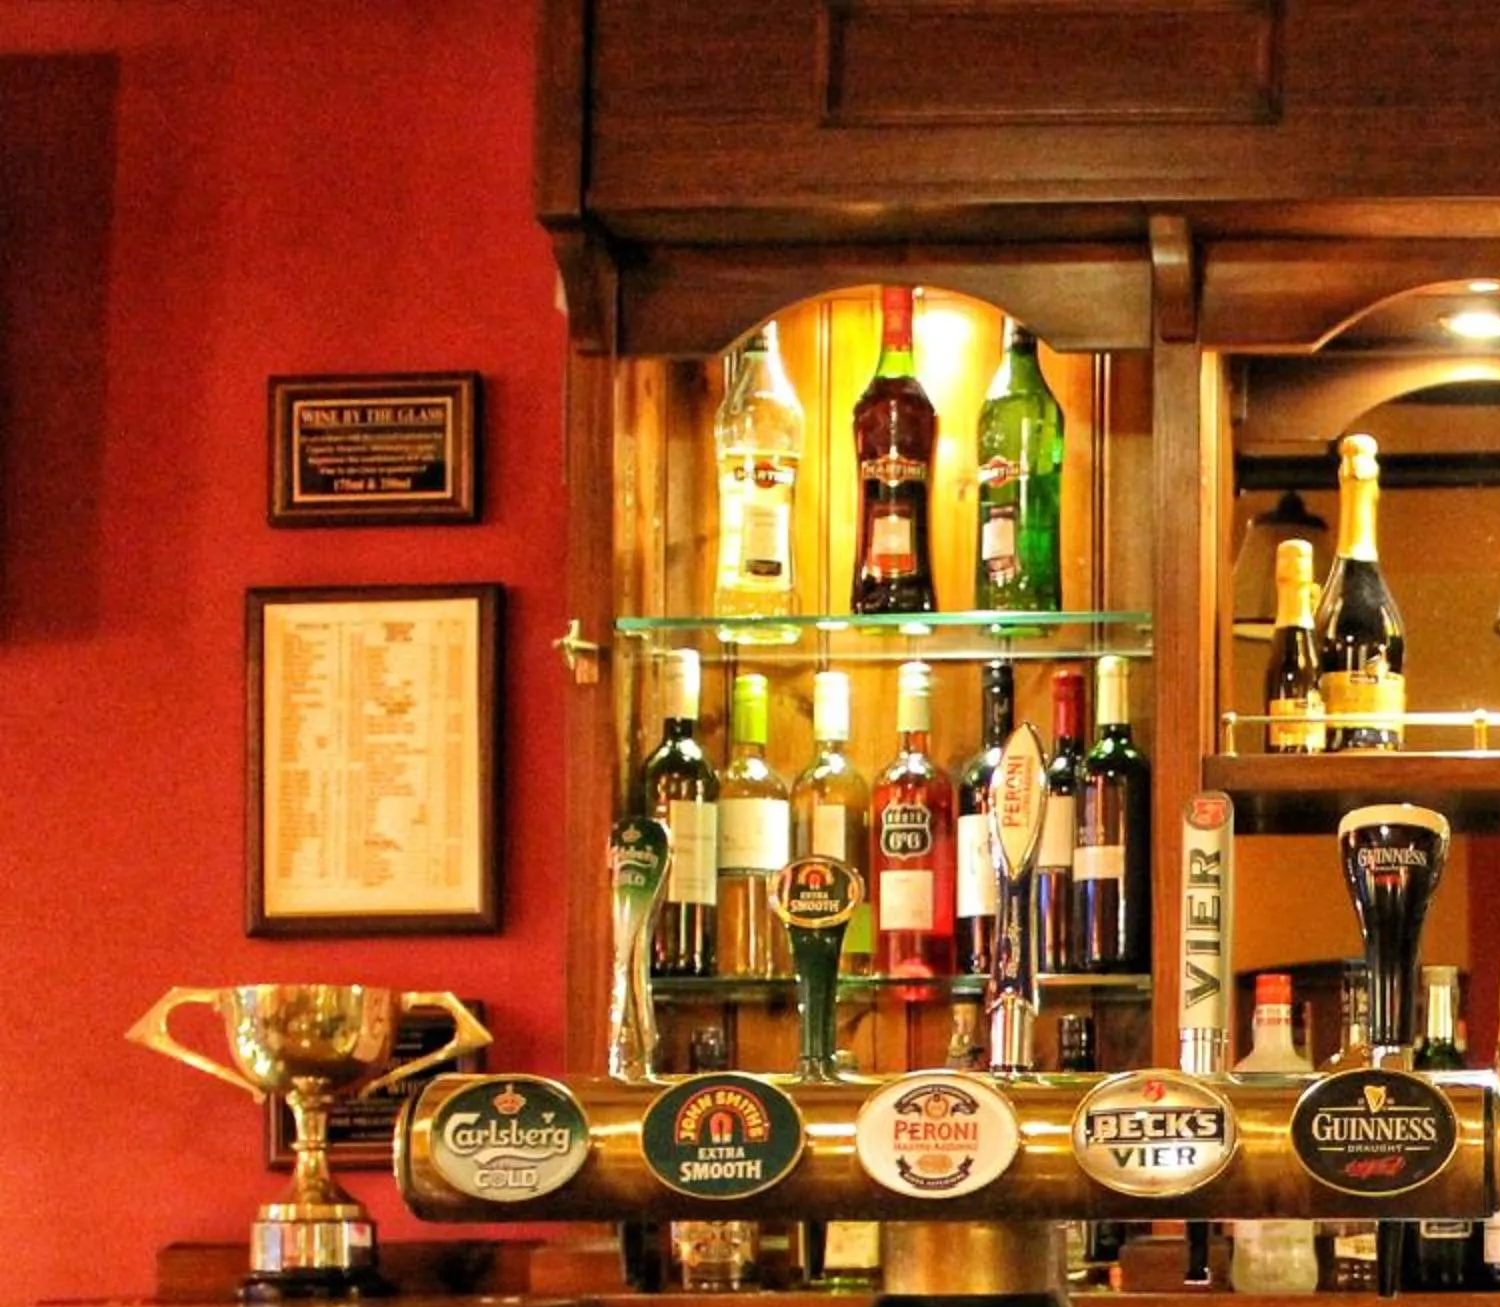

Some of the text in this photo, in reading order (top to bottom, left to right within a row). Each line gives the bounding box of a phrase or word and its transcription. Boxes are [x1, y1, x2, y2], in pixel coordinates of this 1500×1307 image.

[301, 409, 338, 424] WINE
[343, 409, 361, 423] BY
[366, 408, 395, 422] THE
[1003, 755, 1025, 828] PERONI
[1358, 847, 1428, 867] GUINNESS
[1185, 847, 1221, 1010] VIER
[680, 1093, 712, 1141] JOHN
[1093, 1111, 1217, 1139] BECK'S
[1312, 1113, 1437, 1141] GUINNESS
[443, 1112, 571, 1155] Carlsberg
[894, 1119, 978, 1141] PERONI
[698, 1146, 745, 1161] EXTRA
[1108, 1146, 1196, 1168] VIER
[1347, 1144, 1402, 1153] DRAUGHT
[680, 1159, 762, 1182] SMOOTH
